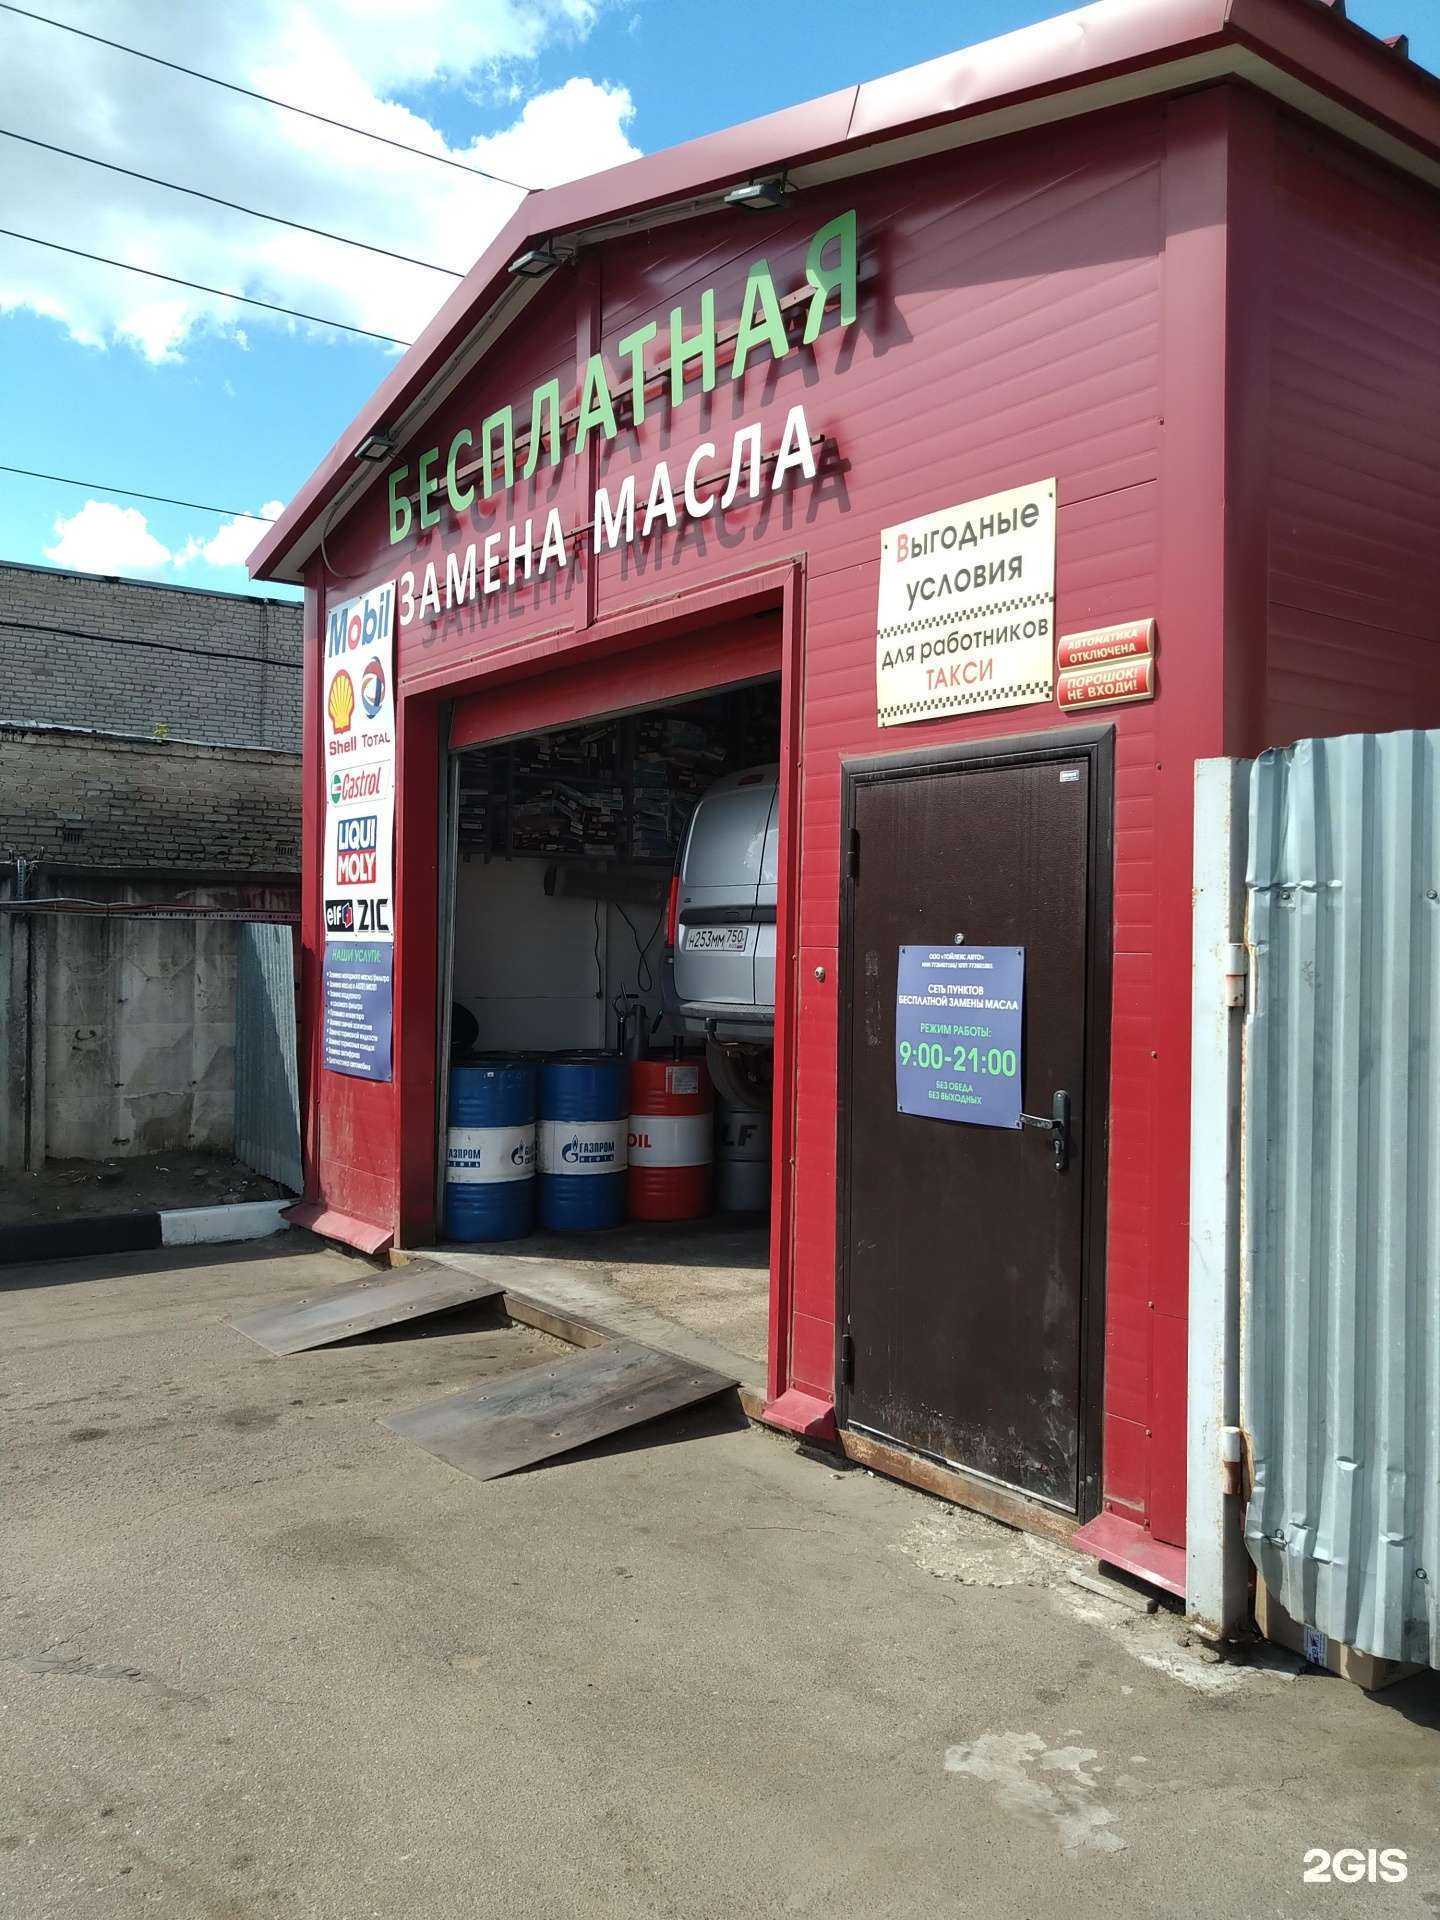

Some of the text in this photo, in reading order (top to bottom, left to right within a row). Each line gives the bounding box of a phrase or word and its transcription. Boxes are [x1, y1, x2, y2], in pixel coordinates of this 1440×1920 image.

[388, 208, 857, 546] БЕСПЛАТНАЯ
[399, 405, 817, 626] ЗАМЕНА МАСЛА
[329, 590, 391, 658] Mobil
[881, 618, 1048, 670] для работников
[1068, 629, 1138, 650] АВТОМАТИКА
[1069, 643, 1137, 663] ОТКЛЮЧЕНА
[926, 658, 994, 691] ТАКСИ
[1067, 667, 1138, 689] ПОРОШОК!
[1067, 680, 1138, 701] НЕ ВХОДИ!
[329, 732, 391, 756] Shell TOTAL
[341, 767, 382, 801] Castrol
[338, 819, 377, 851] LIQUI
[338, 853, 376, 883] MOLY
[326, 899, 389, 931] elf ZIC
[726, 930, 744, 943] 750
[928, 984, 984, 996] СЕТЬ ПУНКТОВ
[898, 995, 1019, 1010] БЕСПЛАТНОЙ ЗАМЕНЫ МАСЛА
[920, 1022, 992, 1038] РЕЖИМ РАБОТЫ:
[899, 1041, 1016, 1077] 9:00-21:00
[928, 1090, 982, 1105] БЕЗ ВЫХОДНЫХ
[936, 1080, 973, 1093] БЕЗ ОБЕДА
[448, 1149, 481, 1160] АЗПРОМ
[579, 1142, 615, 1153] ГАЗПРОМ
